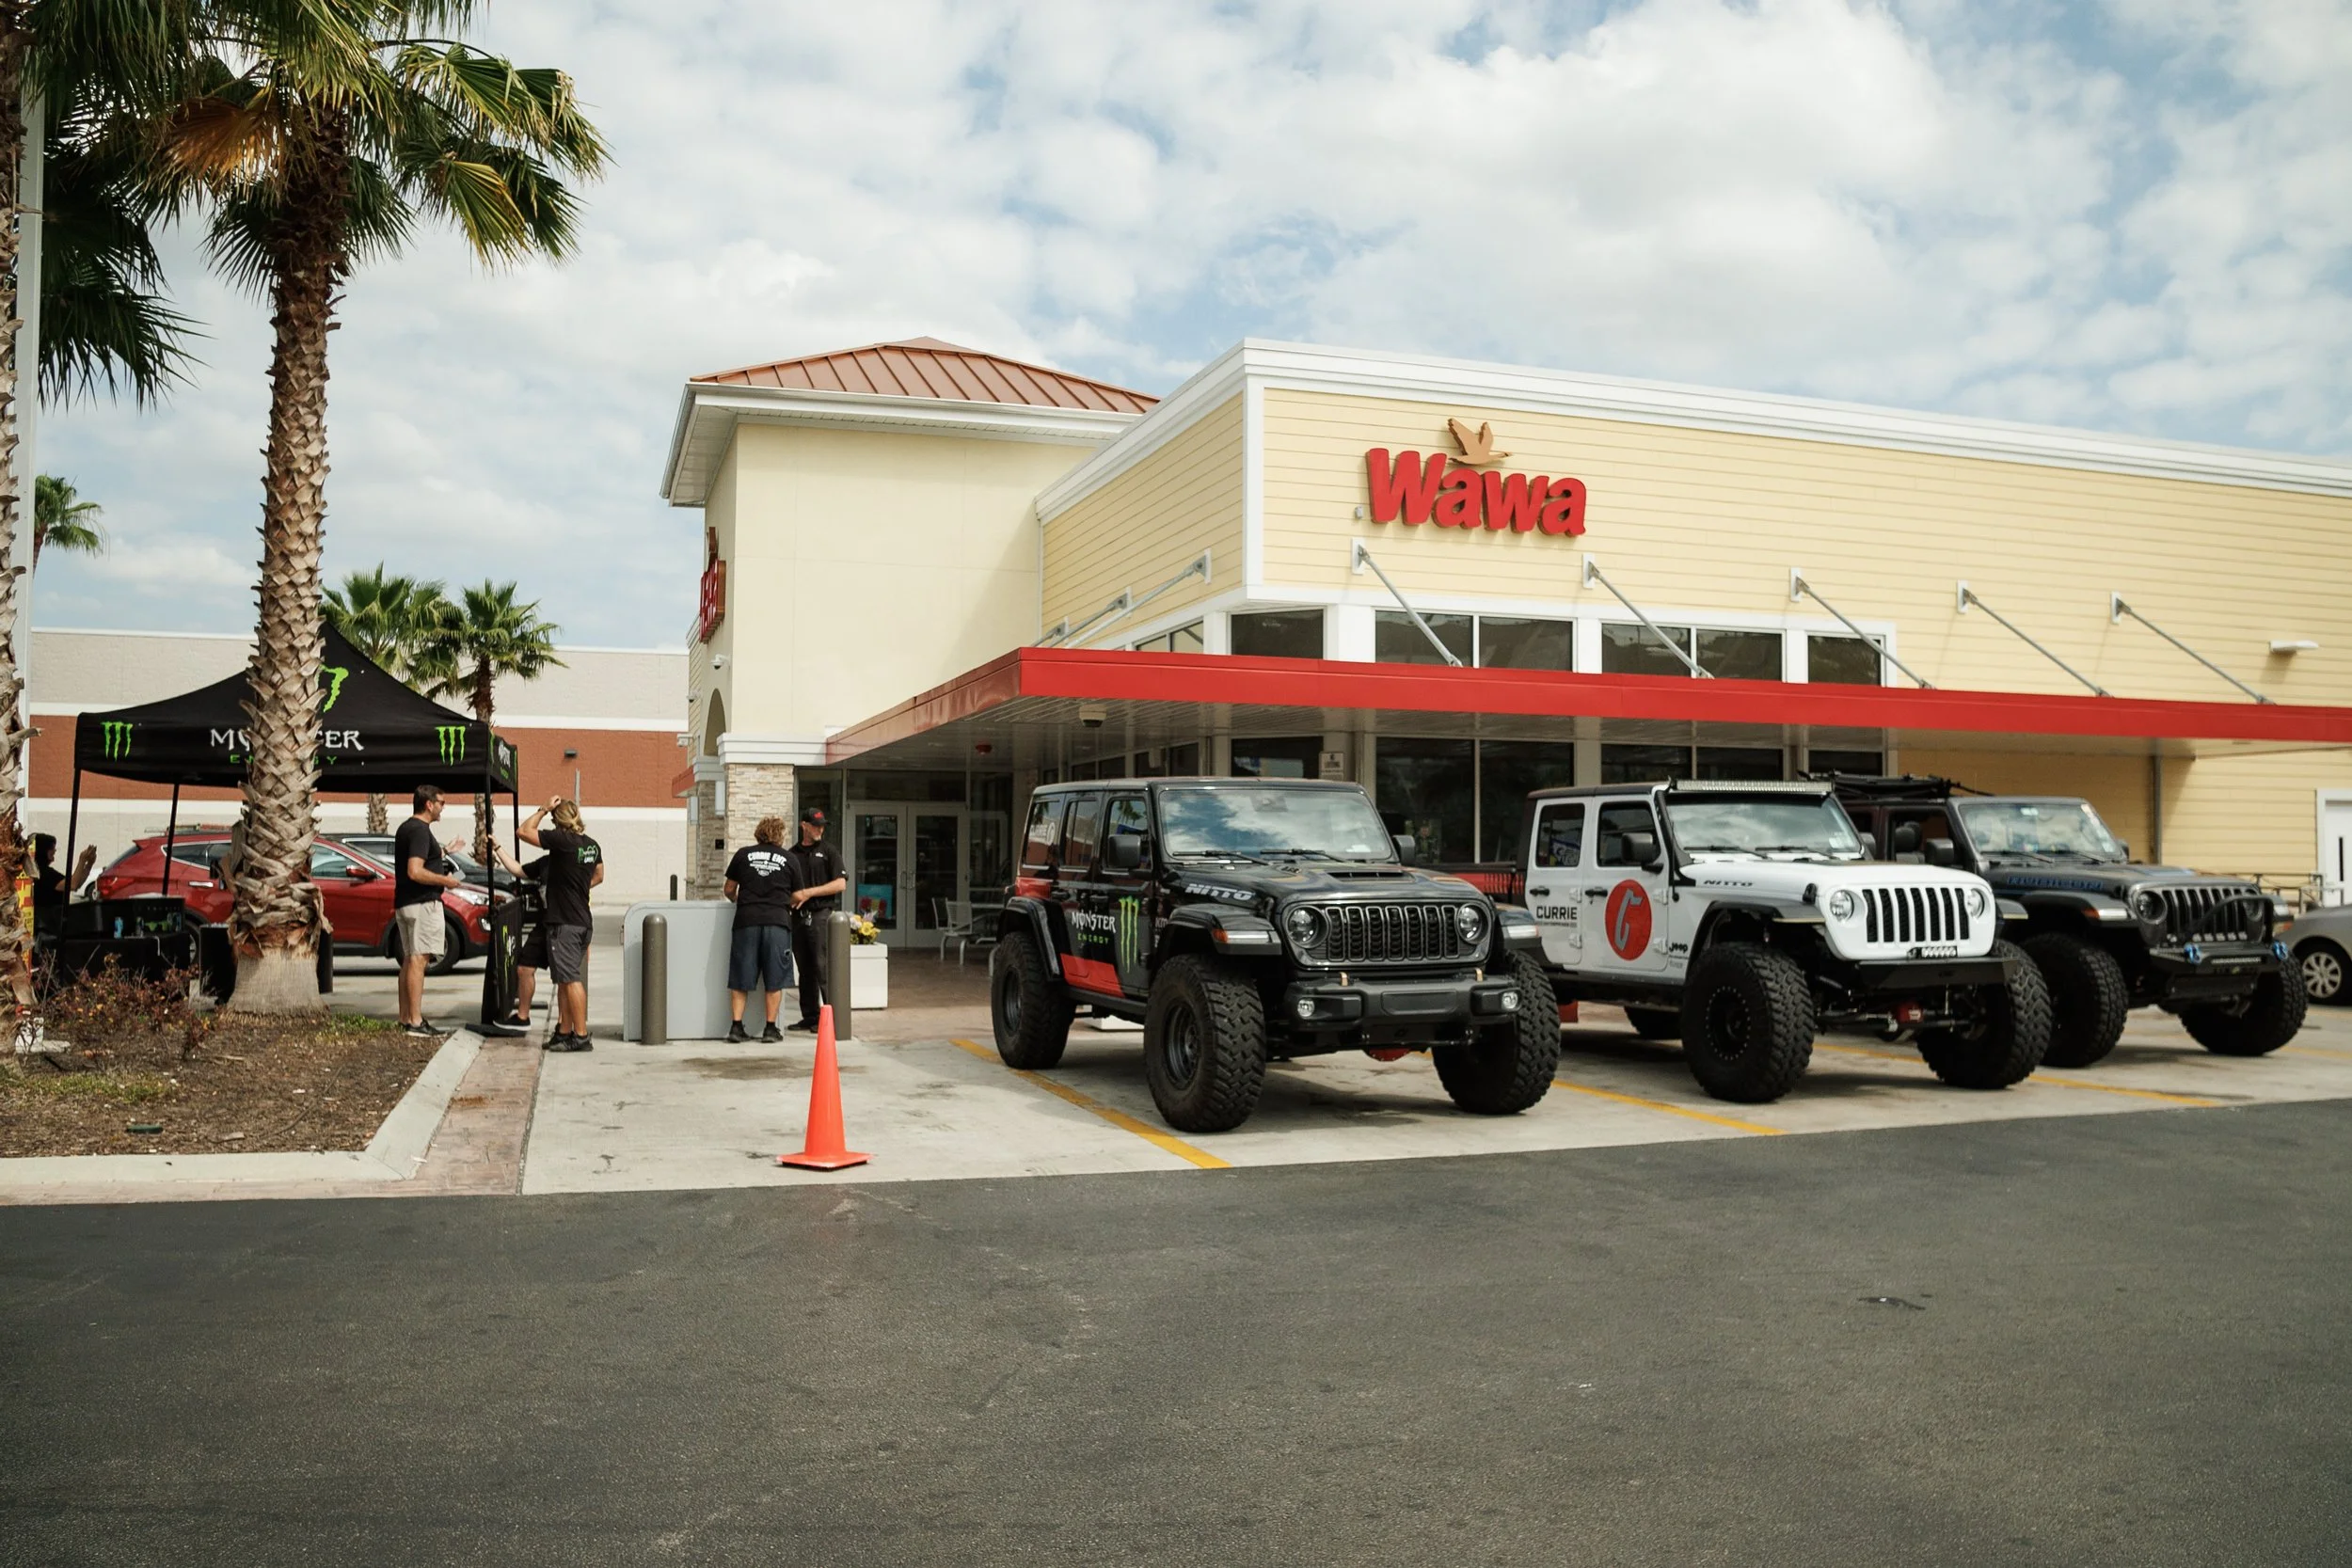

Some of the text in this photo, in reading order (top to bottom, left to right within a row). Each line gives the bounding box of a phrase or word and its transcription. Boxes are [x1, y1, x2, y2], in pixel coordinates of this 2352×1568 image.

[1366, 447, 1587, 537] Wawa
[210, 727, 364, 752] MOER
[1185, 883, 1255, 900] NITTO
[1072, 910, 1117, 933] MONSTER
[1536, 906, 1578, 920] CURRIE
[1077, 933, 1108, 944] ENERGY
[1669, 942, 1688, 954] Jeep
